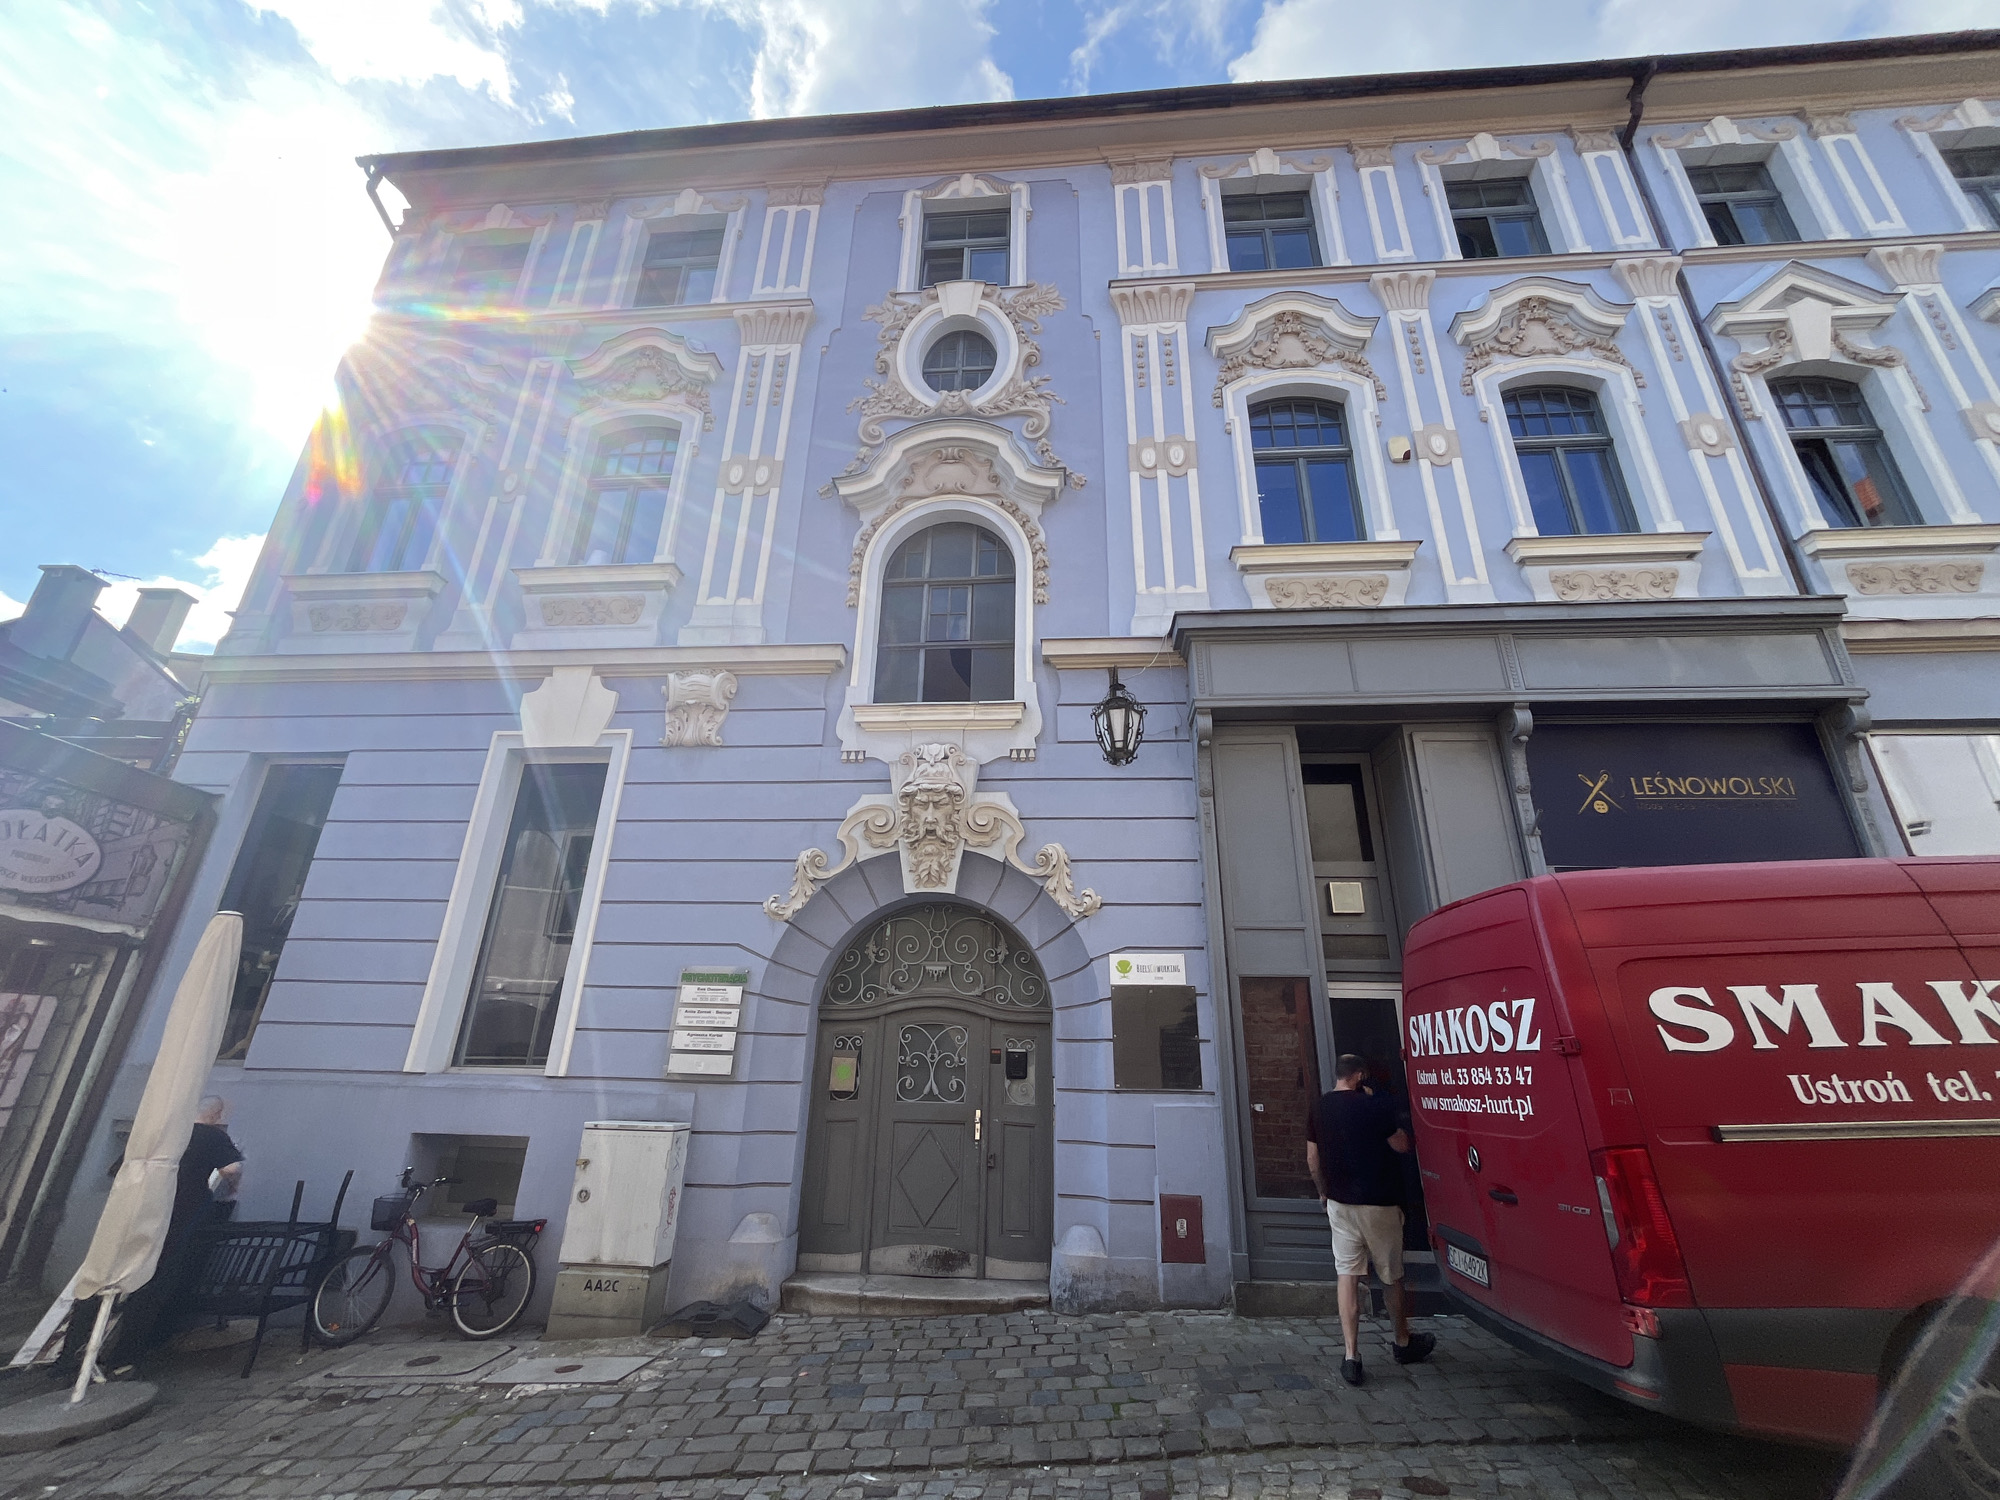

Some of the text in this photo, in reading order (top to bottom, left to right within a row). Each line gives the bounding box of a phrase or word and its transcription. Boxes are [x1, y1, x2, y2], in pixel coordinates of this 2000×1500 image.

[1630, 771, 1796, 796] LEŚNOWOLSKI
[1409, 998, 1542, 1058] SMAKOSZ
[1416, 1066, 1532, 1086] Ustroń tel. 33 854 33 47
[1787, 1070, 1992, 1105] Ustroń tel.
[583, 1279, 620, 1293] AA2C
